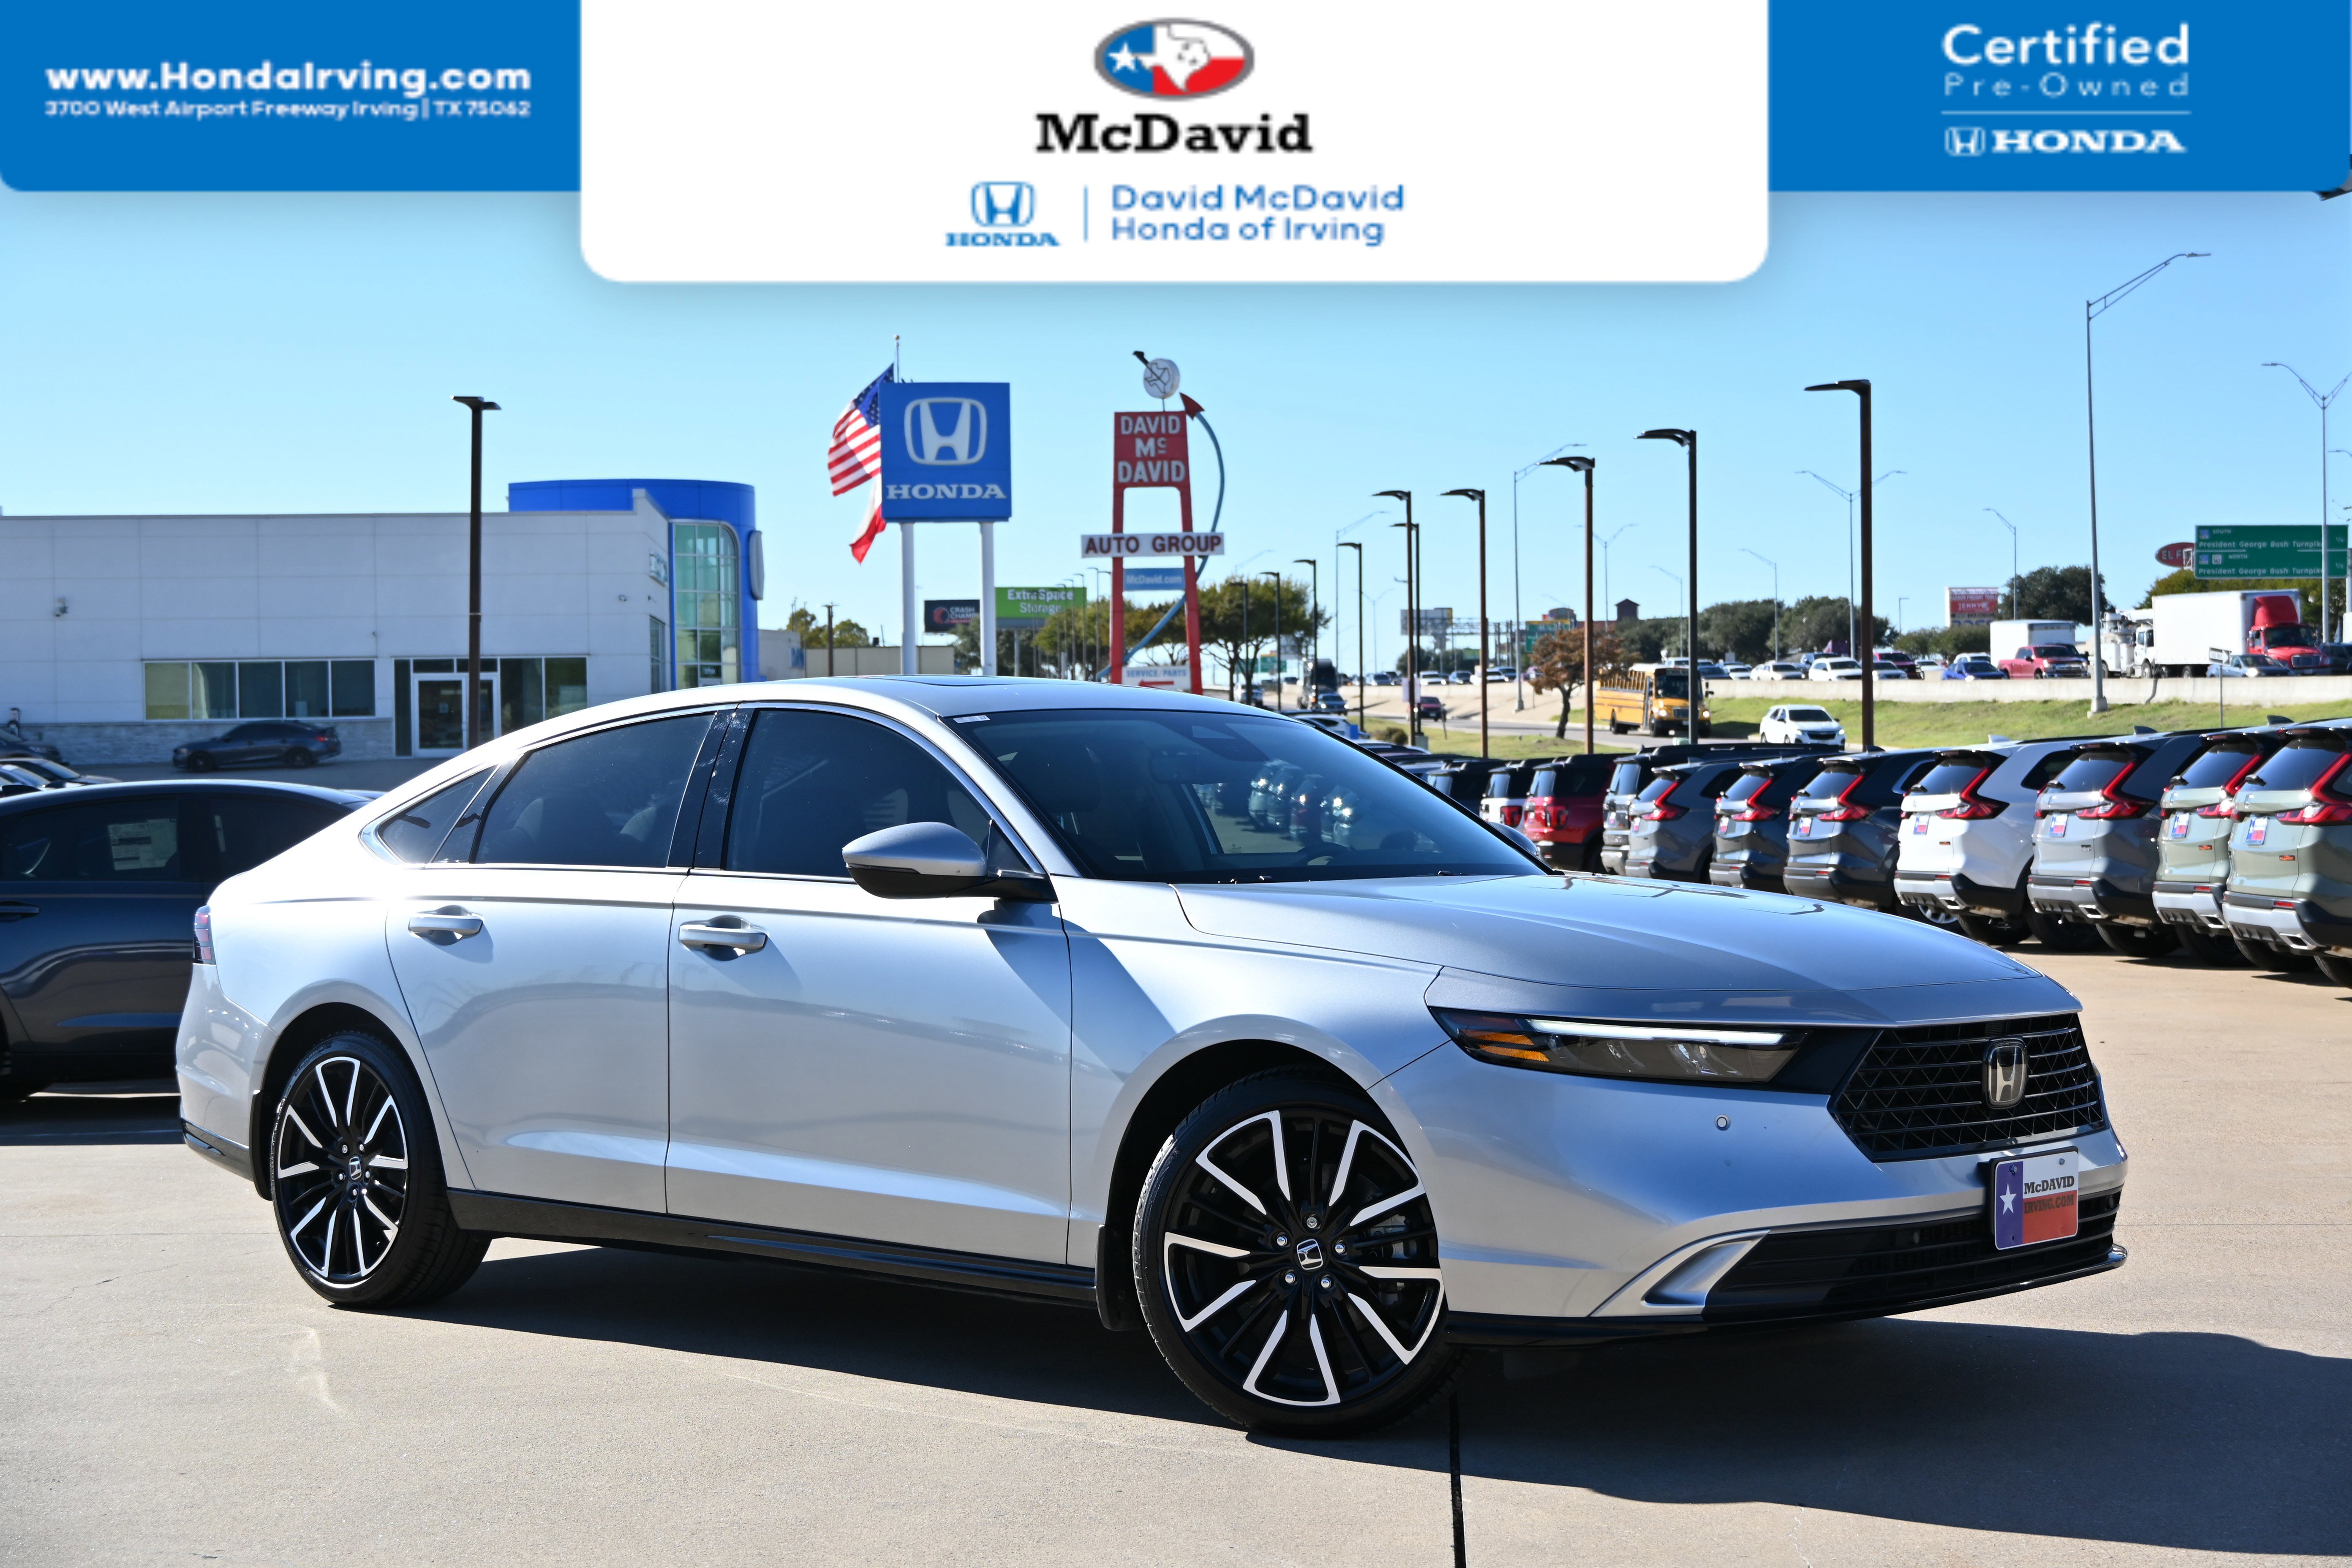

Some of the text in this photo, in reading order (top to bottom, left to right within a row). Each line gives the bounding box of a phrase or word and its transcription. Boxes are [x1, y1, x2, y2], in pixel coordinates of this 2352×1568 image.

[1121, 415, 1180, 435] DAVID
[1118, 460, 1185, 483] DAVID
[886, 484, 1006, 499] HONDA
[1085, 535, 1221, 554] AUTO GROUP
[1127, 574, 1182, 584] McDavid.com
[1007, 589, 1073, 602] Extra Space
[2024, 1176, 2074, 1195] McDAVID
[2024, 1194, 2074, 1214] IRVING.COM
